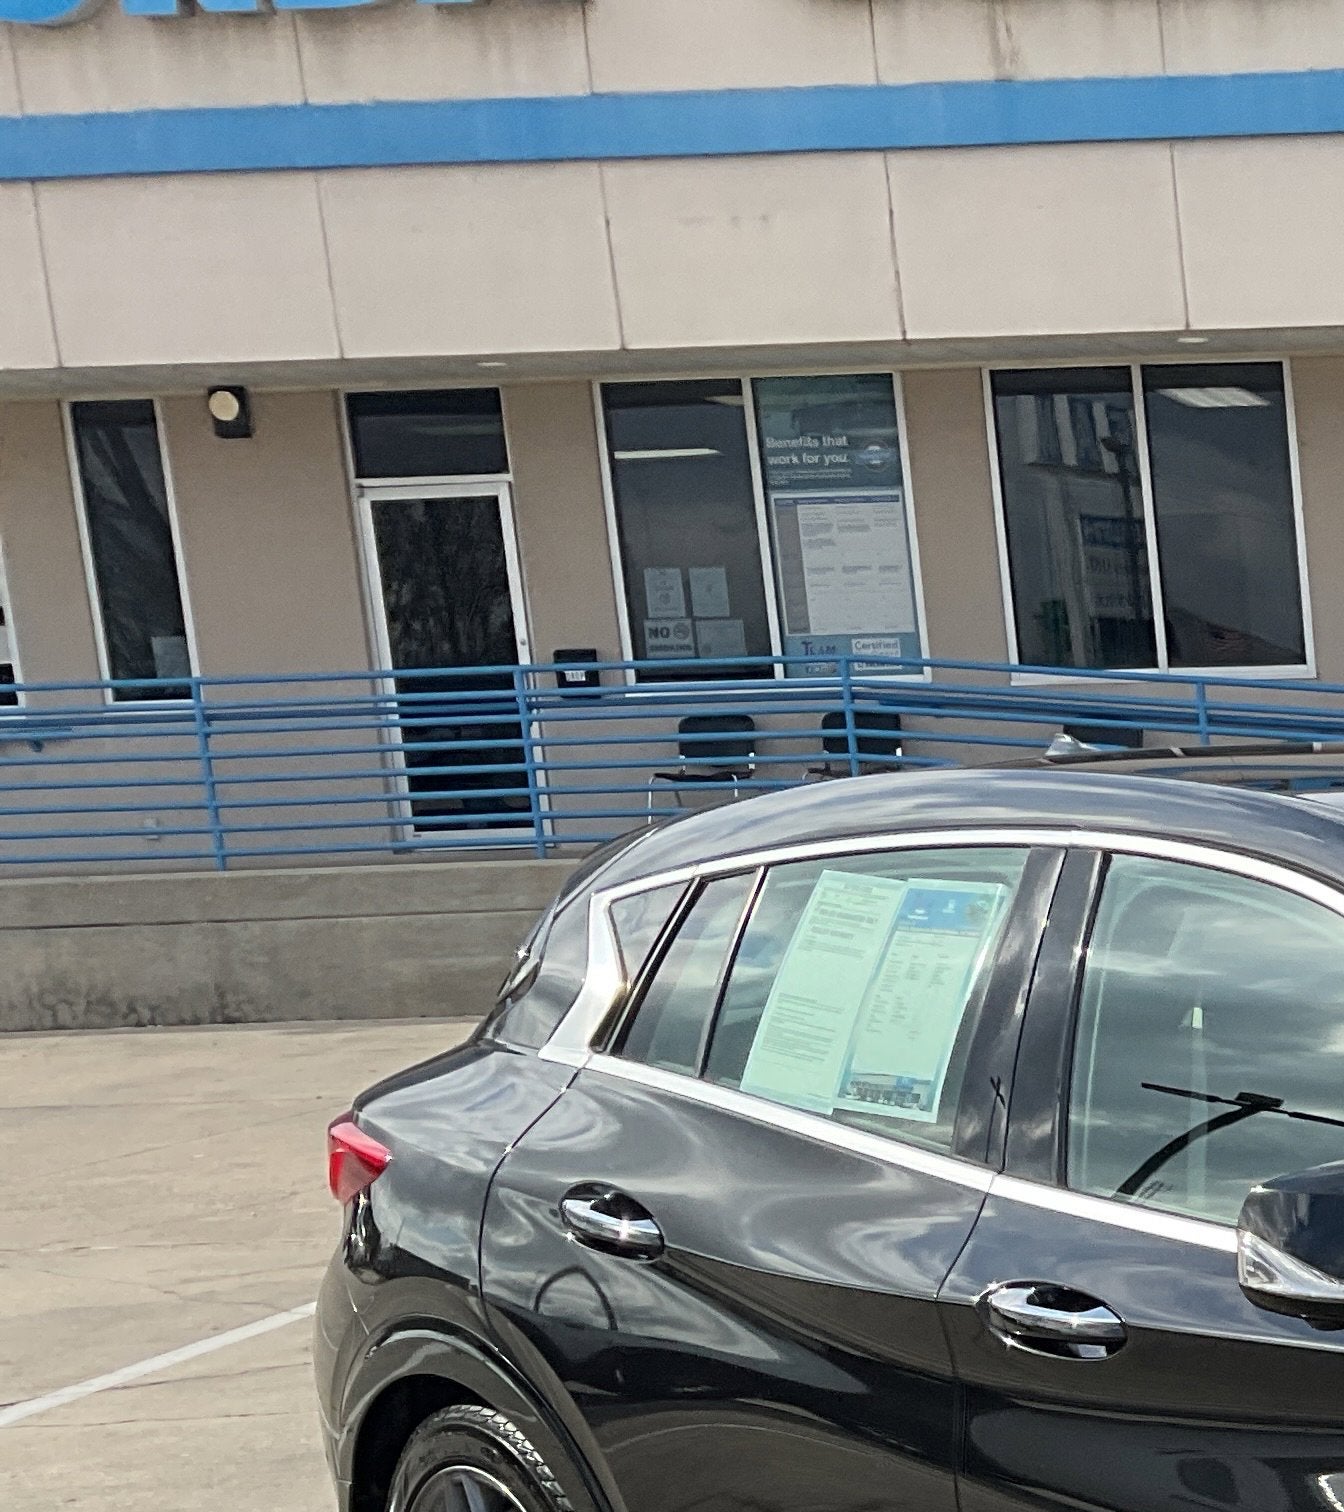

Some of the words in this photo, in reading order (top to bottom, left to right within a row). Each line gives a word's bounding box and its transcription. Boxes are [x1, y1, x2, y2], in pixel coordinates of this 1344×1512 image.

[822, 435, 849, 447] that
[767, 453, 799, 465] work
[802, 452, 819, 464] for
[648, 626, 671, 640] NO
[854, 640, 899, 651] Certified
